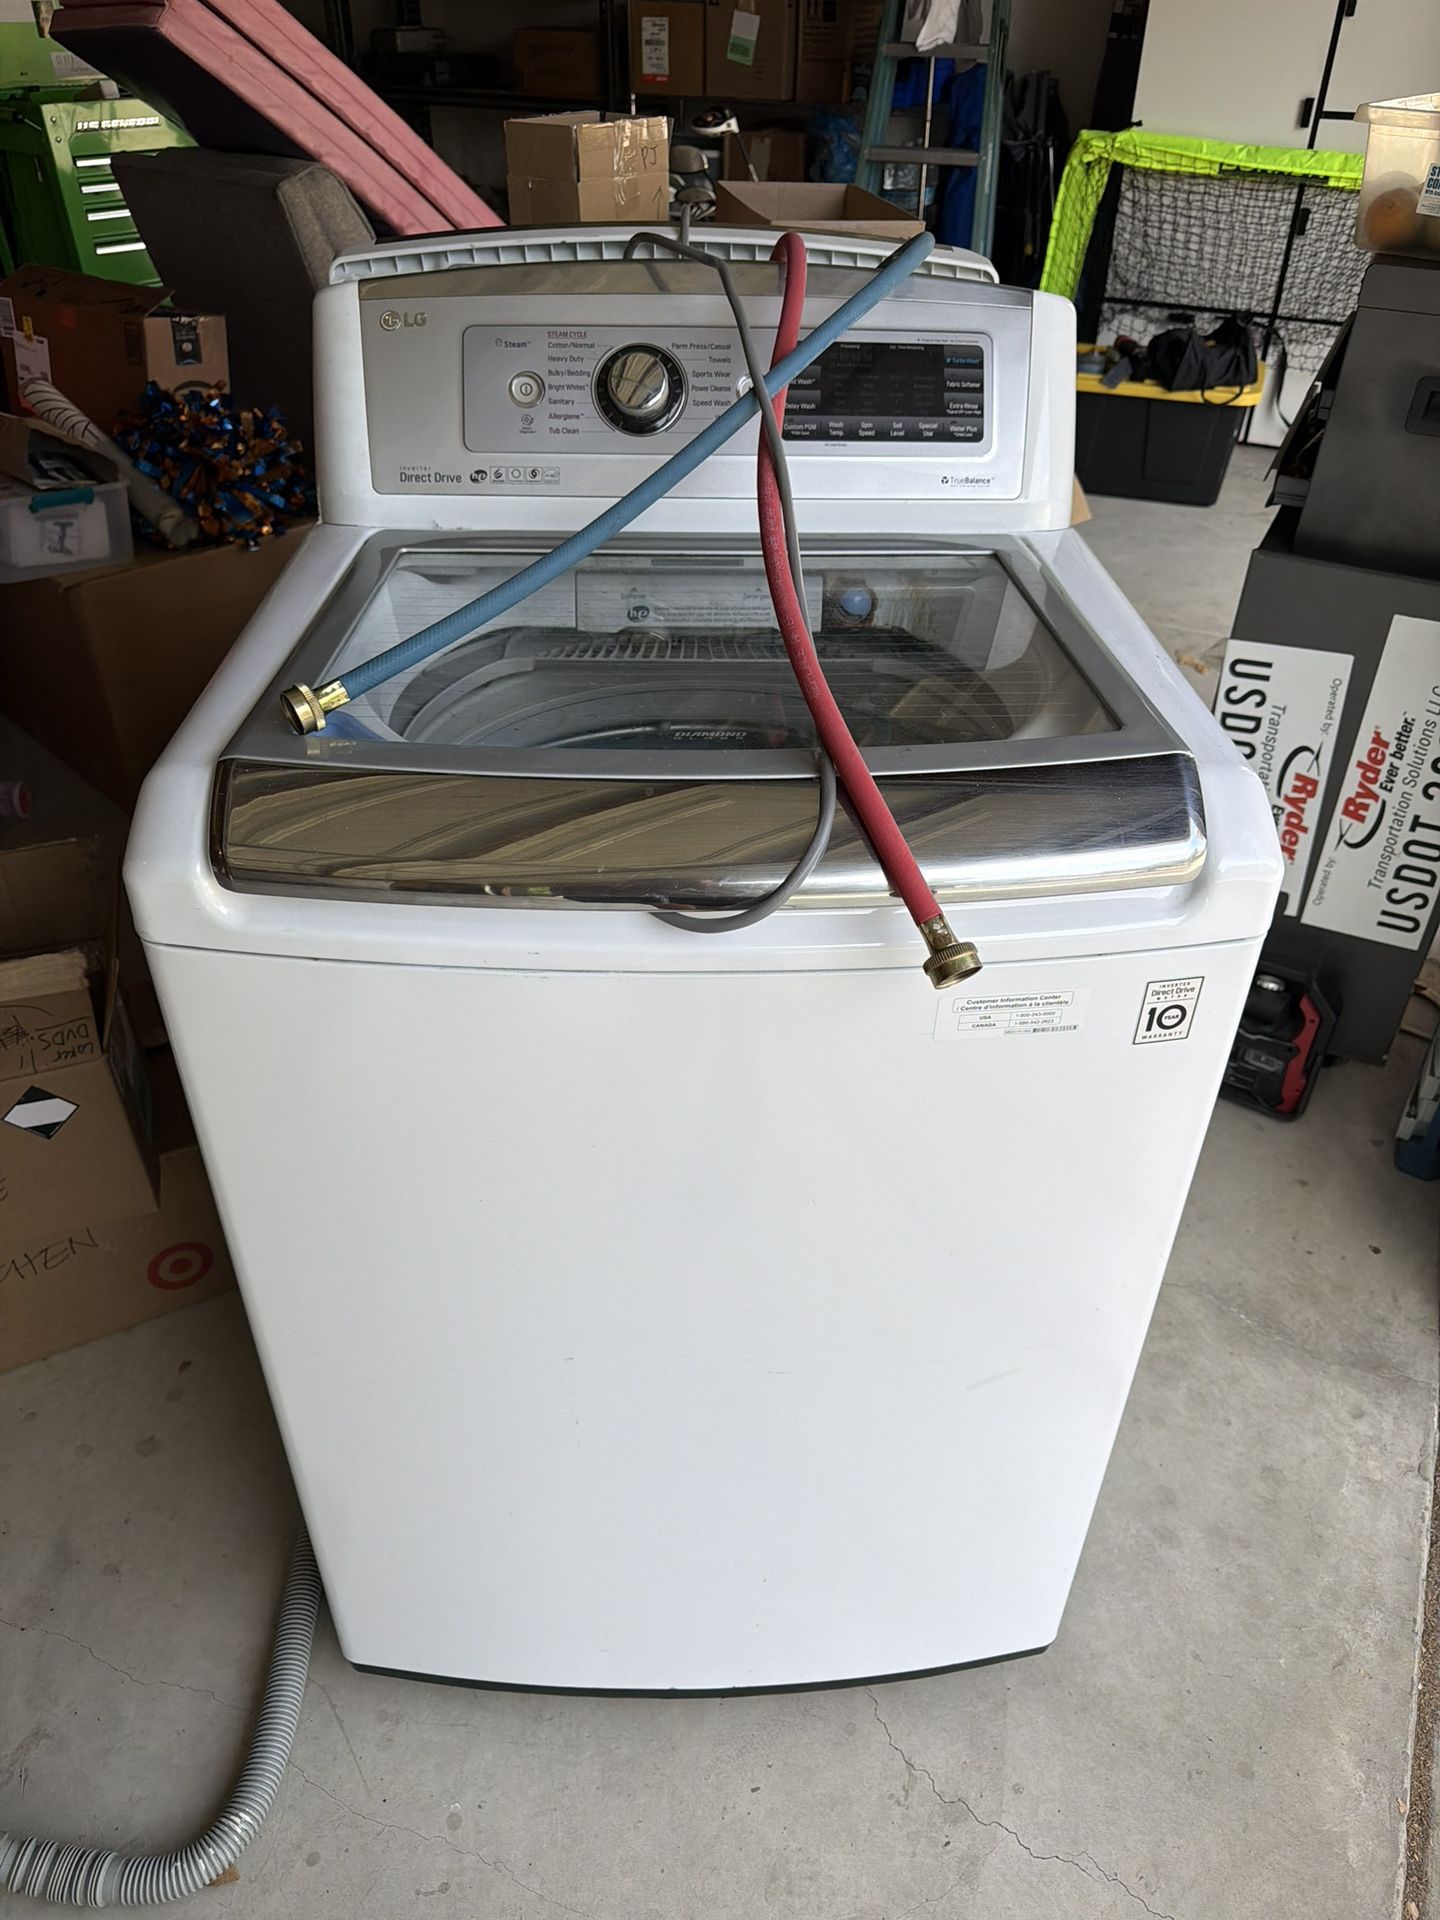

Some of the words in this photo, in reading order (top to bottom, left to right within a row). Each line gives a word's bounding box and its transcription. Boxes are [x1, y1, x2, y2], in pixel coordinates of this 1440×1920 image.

[403, 312, 427, 328] LG
[547, 355, 567, 363] Heavy
[569, 355, 584, 363] Duty
[547, 369, 592, 378] Bulky/Bedding
[692, 370, 713, 378] Sports
[547, 384, 565, 392] Bright
[548, 398, 575, 406] Sanitary
[692, 400, 713, 408] Speed
[400, 472, 432, 483] Direct
[434, 472, 463, 483] Drive
[1341, 726, 1391, 825] Ryder
[1378, 762, 1400, 793] Ever
[1367, 791, 1414, 890] Transportation
[1402, 719, 1438, 788] Solutions
[1280, 772, 1319, 865] Ryder
[1376, 814, 1440, 934] USDOT
[1151, 989, 1175, 997] Direct
[1146, 1004, 1187, 1032] 10
[1142, 1031, 1183, 1040] WARRANTY
